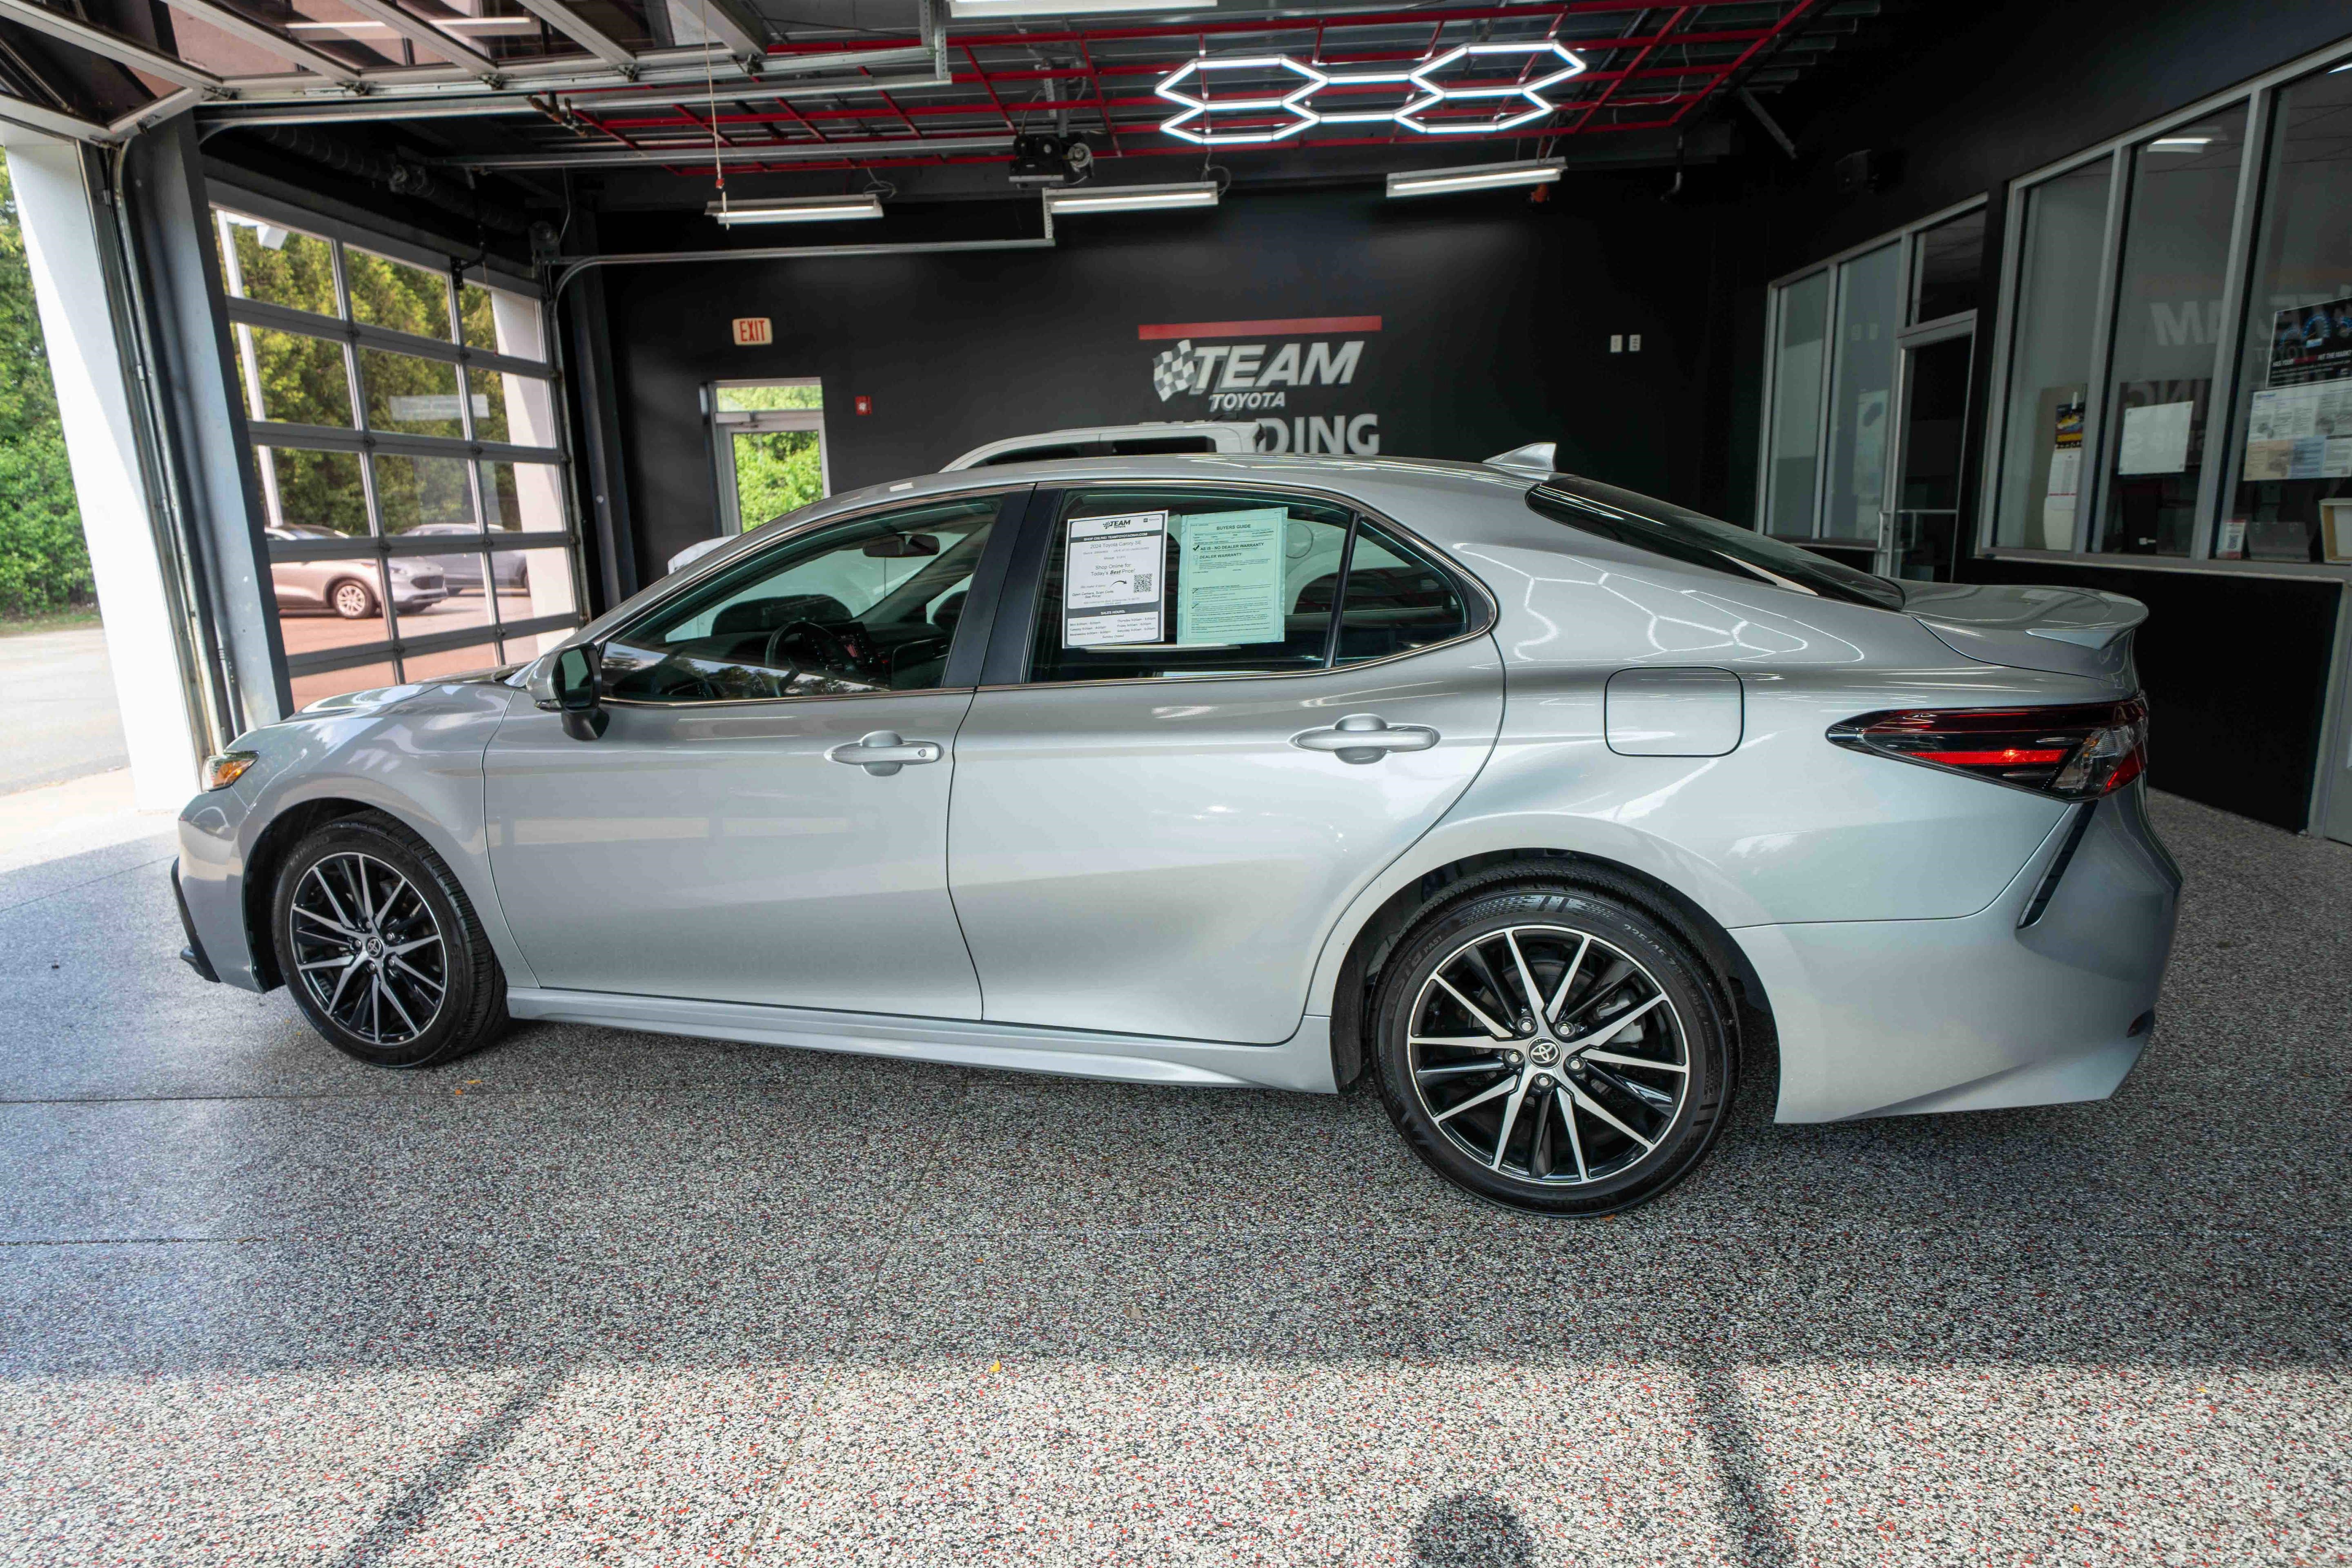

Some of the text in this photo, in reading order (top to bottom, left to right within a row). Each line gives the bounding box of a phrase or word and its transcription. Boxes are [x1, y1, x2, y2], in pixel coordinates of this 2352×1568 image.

[739, 319, 765, 342] EXIT
[1190, 341, 1365, 394] TEAM
[1209, 391, 1286, 412] TOYOTA
